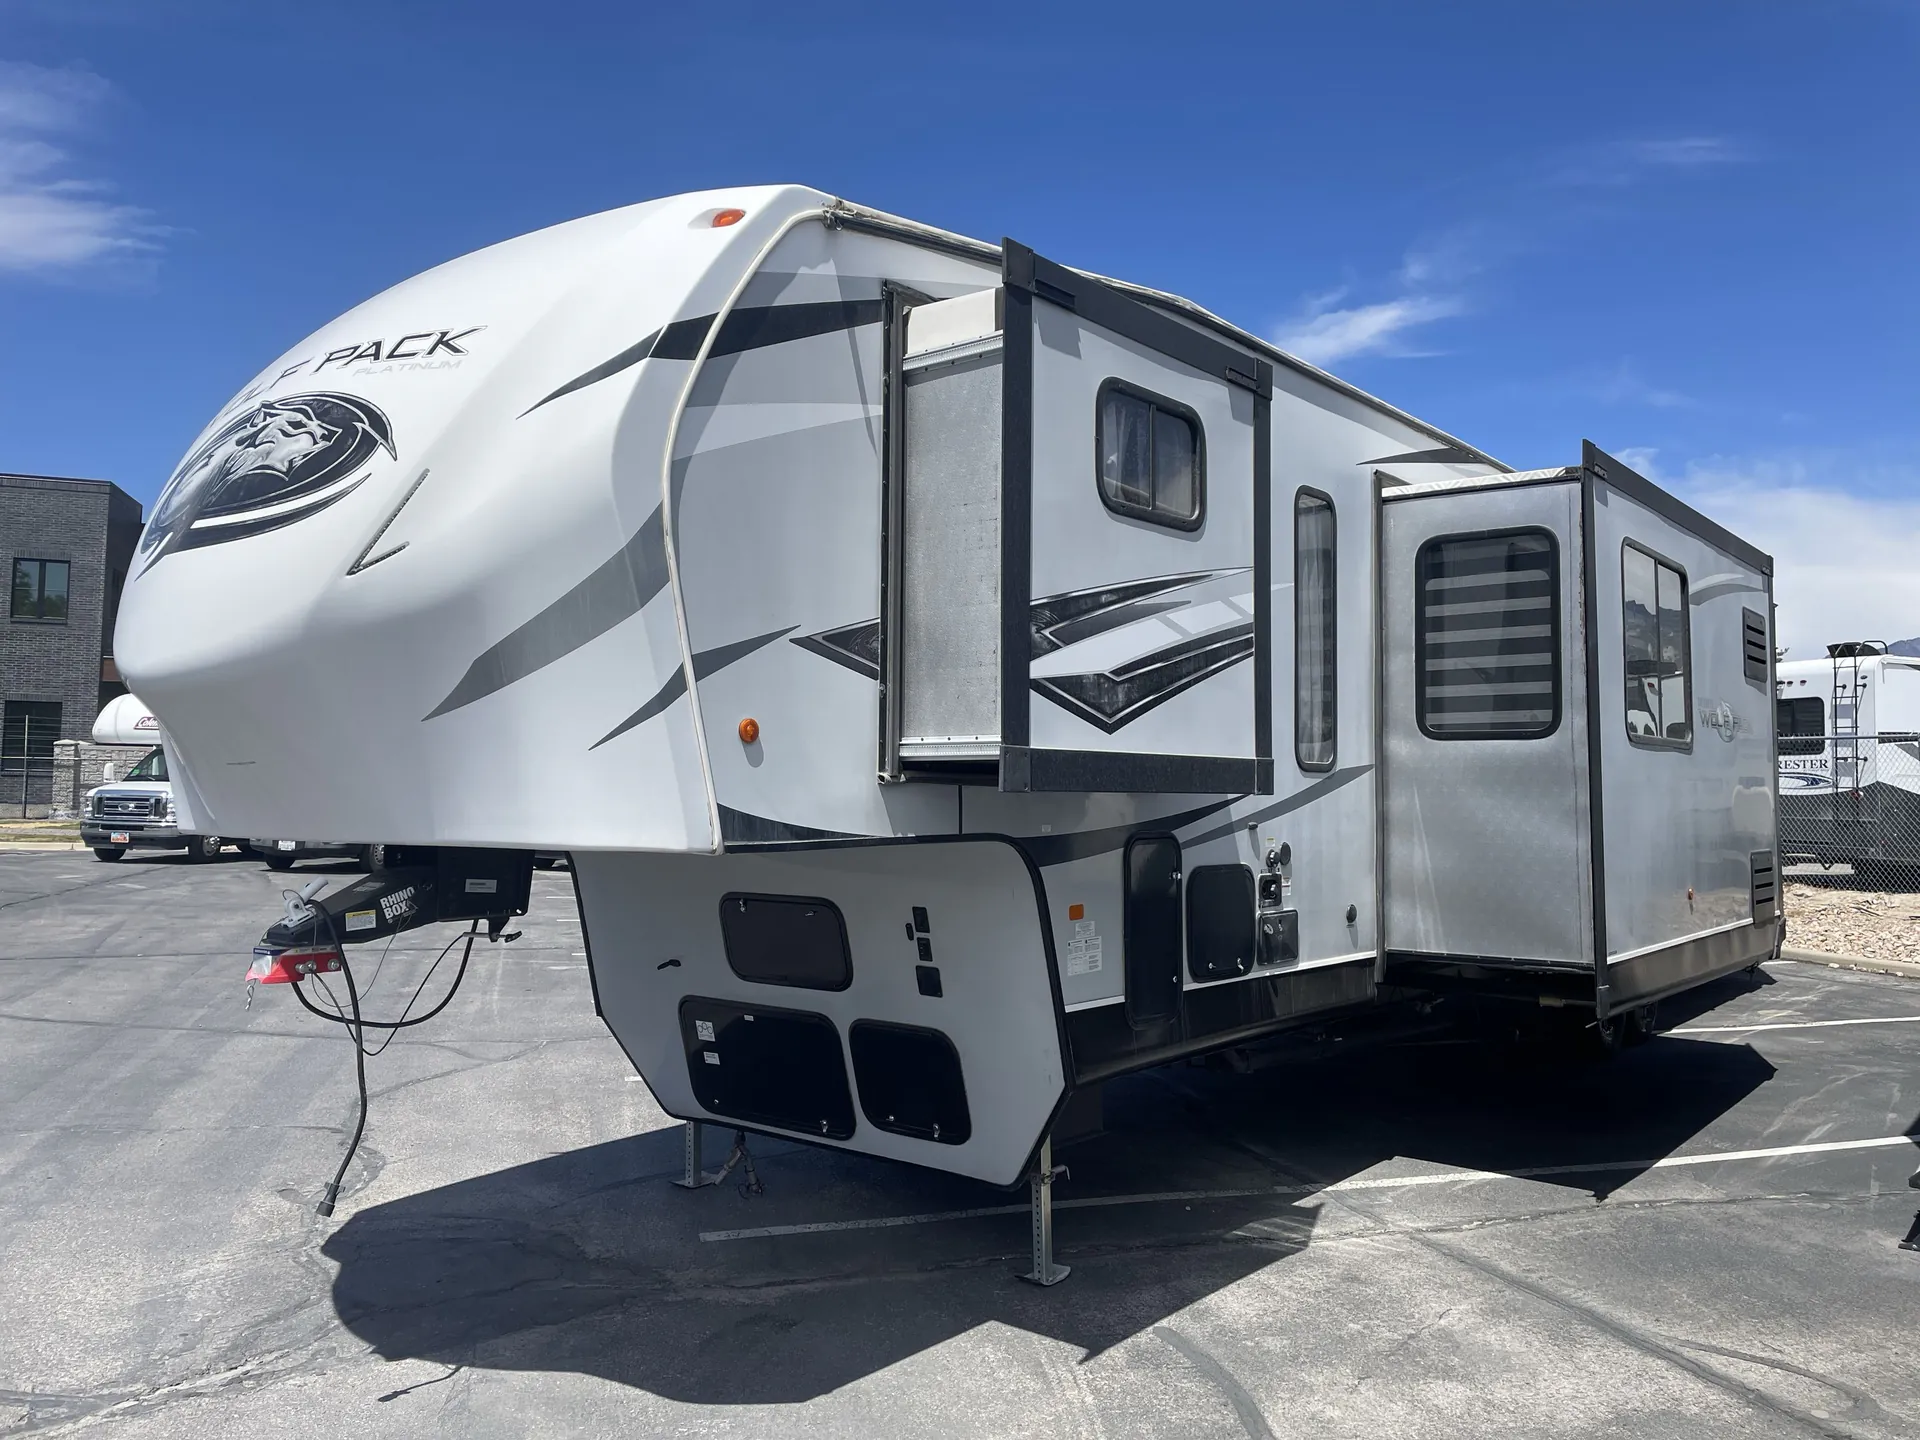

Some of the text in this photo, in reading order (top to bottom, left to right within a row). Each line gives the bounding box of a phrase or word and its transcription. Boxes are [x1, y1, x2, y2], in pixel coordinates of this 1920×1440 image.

[310, 325, 488, 376] PACK
[352, 360, 463, 377] PLATINUM
[380, 886, 415, 908] RHINO
[383, 900, 409, 920] BOX
